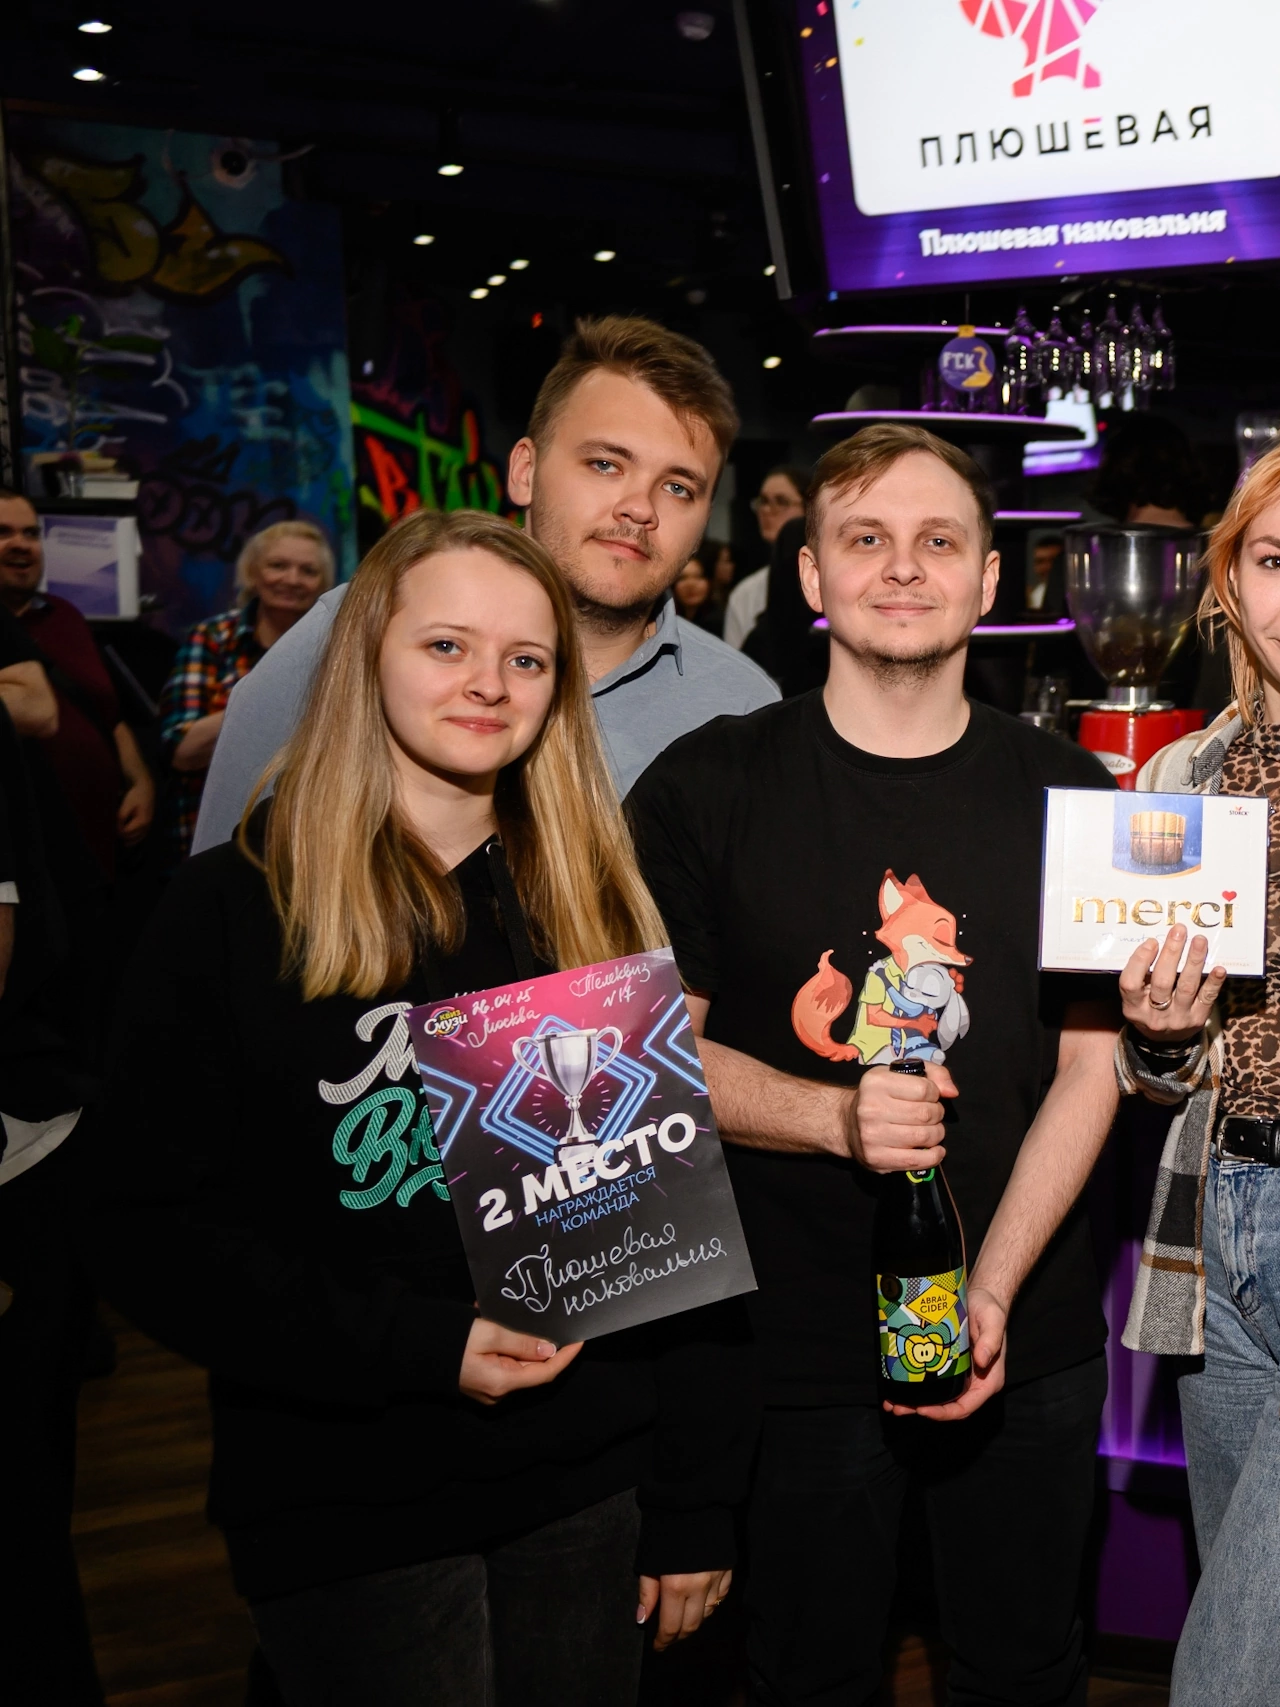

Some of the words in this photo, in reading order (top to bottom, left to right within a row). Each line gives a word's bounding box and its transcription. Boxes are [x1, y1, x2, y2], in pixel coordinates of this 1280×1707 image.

[920, 104, 1215, 169] ПЛЮШЕВАЯ
[919, 219, 1058, 257] Плюшевая
[1062, 208, 1227, 246] наковальня
[1072, 890, 1238, 928] merci
[439, 1009, 461, 1021] КВИЗ
[472, 986, 535, 1015] 26.04.25
[424, 1013, 468, 1035] Смузи
[467, 1005, 542, 1049] Москва
[479, 1188, 514, 1232] 2
[521, 1112, 697, 1216] МЕСТО
[535, 1166, 657, 1227] НАГРАЖДАЕТСЯ
[560, 1192, 640, 1233] КОМАНДА
[501, 1222, 677, 1313] Плюшевая
[563, 1237, 728, 1315] наковальня
[919, 1293, 948, 1305] ABRAU
[919, 1301, 949, 1314] CIDER
